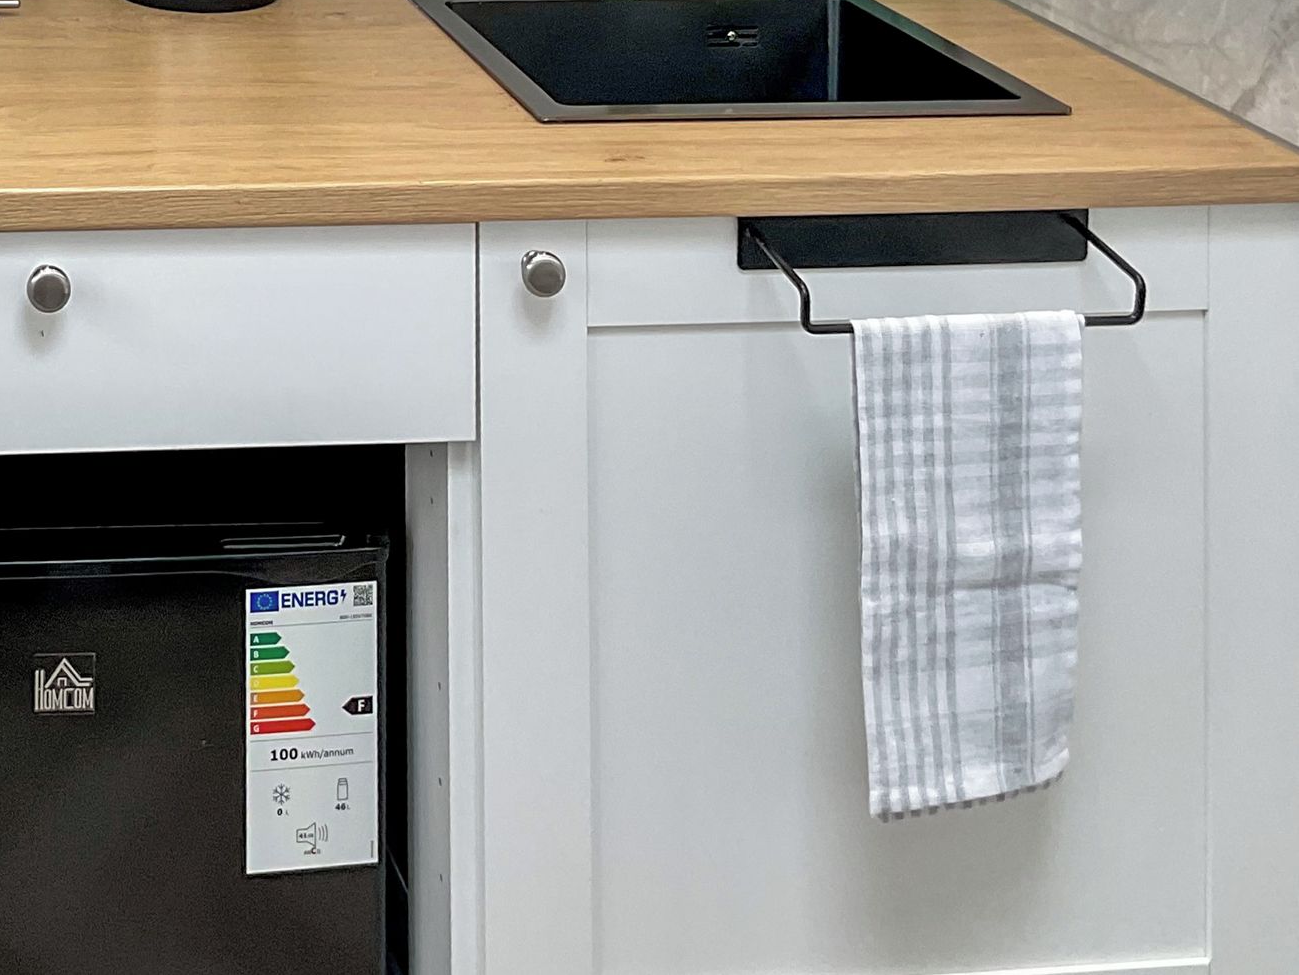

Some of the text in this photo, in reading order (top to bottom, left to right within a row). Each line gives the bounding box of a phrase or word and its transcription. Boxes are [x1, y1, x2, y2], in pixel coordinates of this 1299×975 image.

[281, 589, 339, 608] ENERG
[253, 665, 258, 673] C
[34, 669, 94, 710] HOMCOM
[253, 694, 258, 702] E
[357, 699, 365, 712] F
[253, 724, 259, 733] G
[270, 748, 354, 761] 100 kWh/annum
[277, 808, 282, 816] 0
